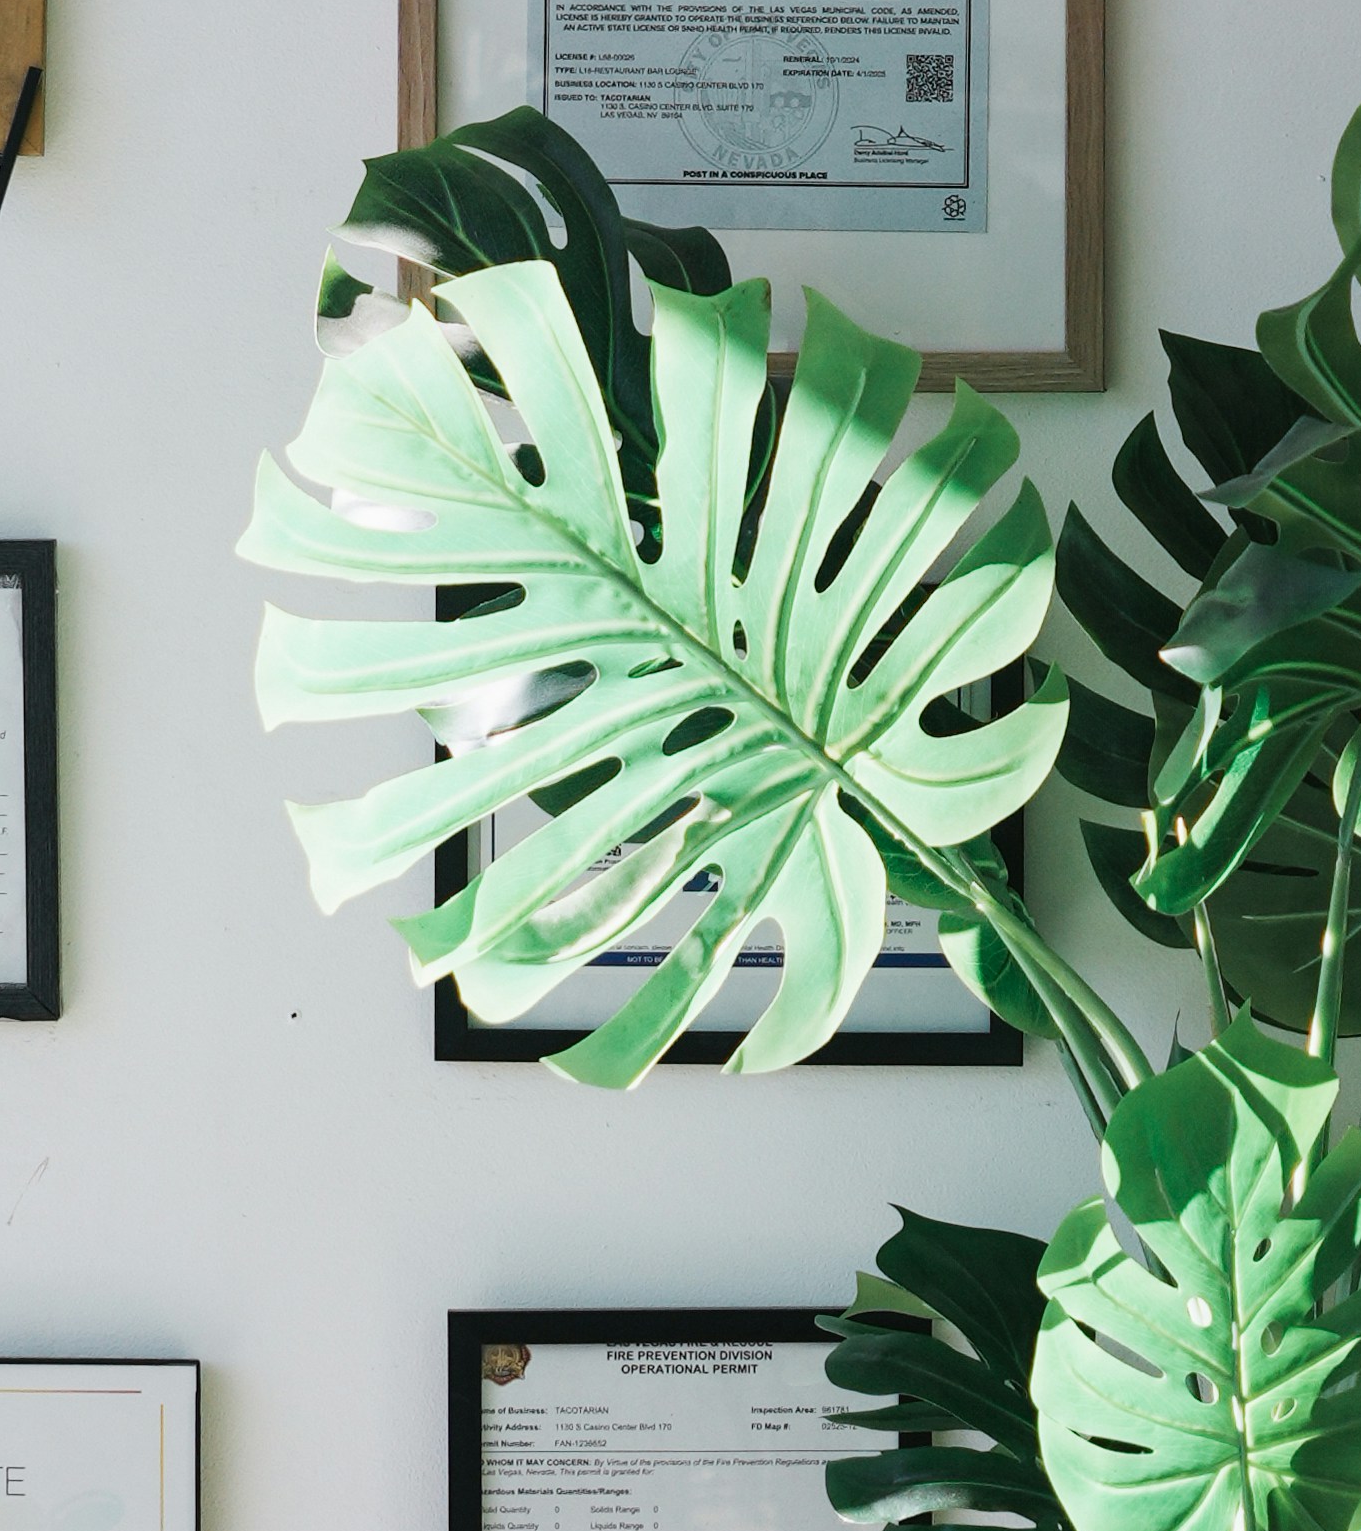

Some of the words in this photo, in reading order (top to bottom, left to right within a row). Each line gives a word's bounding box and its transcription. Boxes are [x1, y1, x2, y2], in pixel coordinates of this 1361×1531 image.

[606, 1350, 634, 1361] FIRE
[637, 1350, 716, 1361] PREVENTION
[719, 1350, 773, 1361] DIVISION
[620, 1363, 710, 1375] OPERATIONAL
[713, 1363, 758, 1375] PERMIT
[555, 1406, 609, 1415] TACOTARIAN
